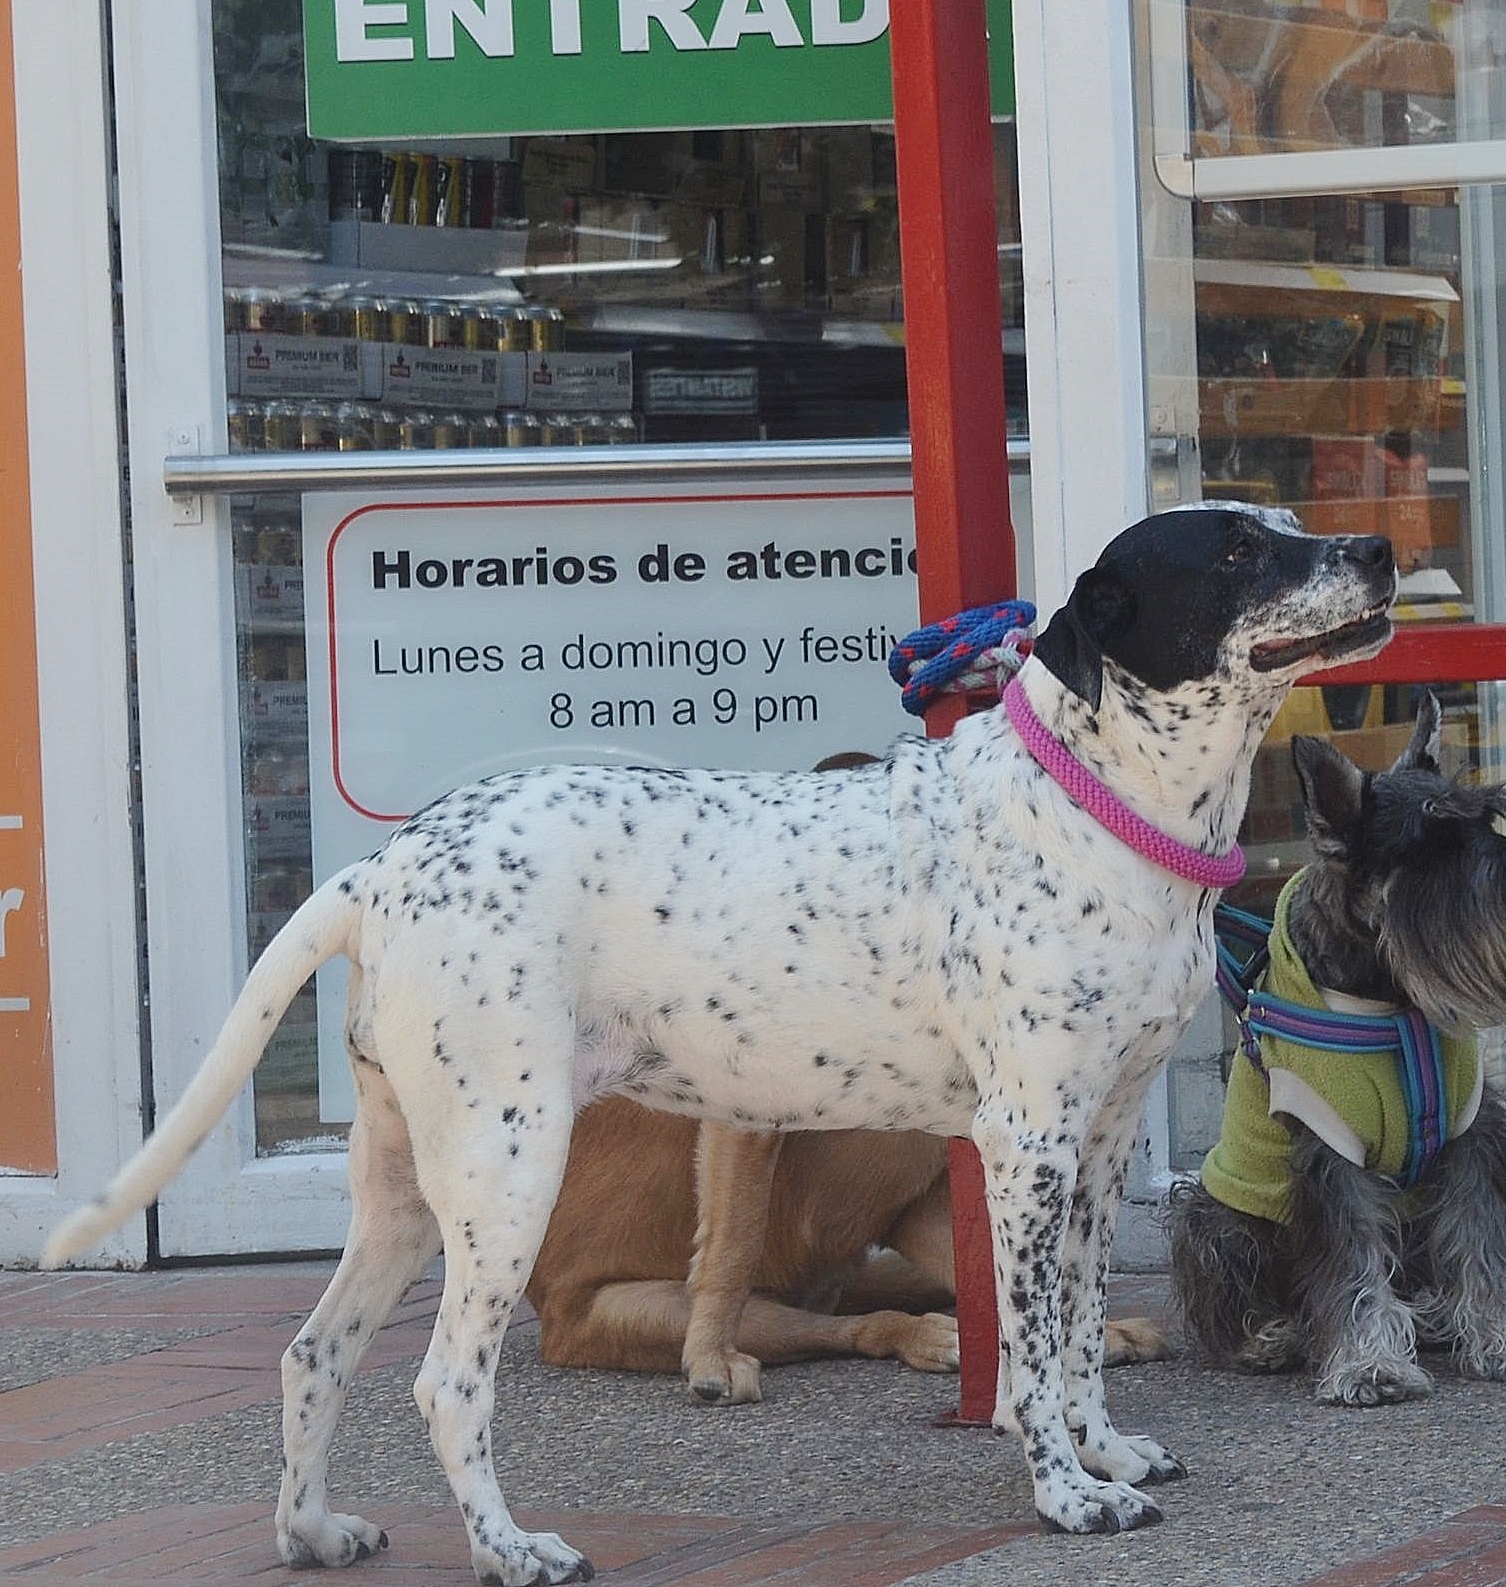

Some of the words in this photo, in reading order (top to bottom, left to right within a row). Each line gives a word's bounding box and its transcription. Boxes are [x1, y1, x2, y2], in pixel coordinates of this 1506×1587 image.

[335, 0, 890, 61] ENTRAD
[373, 547, 617, 589] Horarios
[638, 544, 705, 582] de
[727, 538, 916, 580] atenci
[374, 640, 503, 674] Lunes
[521, 645, 544, 670] a
[562, 632, 746, 675] domingo
[763, 638, 784, 674] y
[550, 693, 573, 728] 8
[591, 700, 654, 727] am
[673, 699, 695, 725] a
[714, 689, 736, 724] 9
[755, 695, 817, 732] pm
